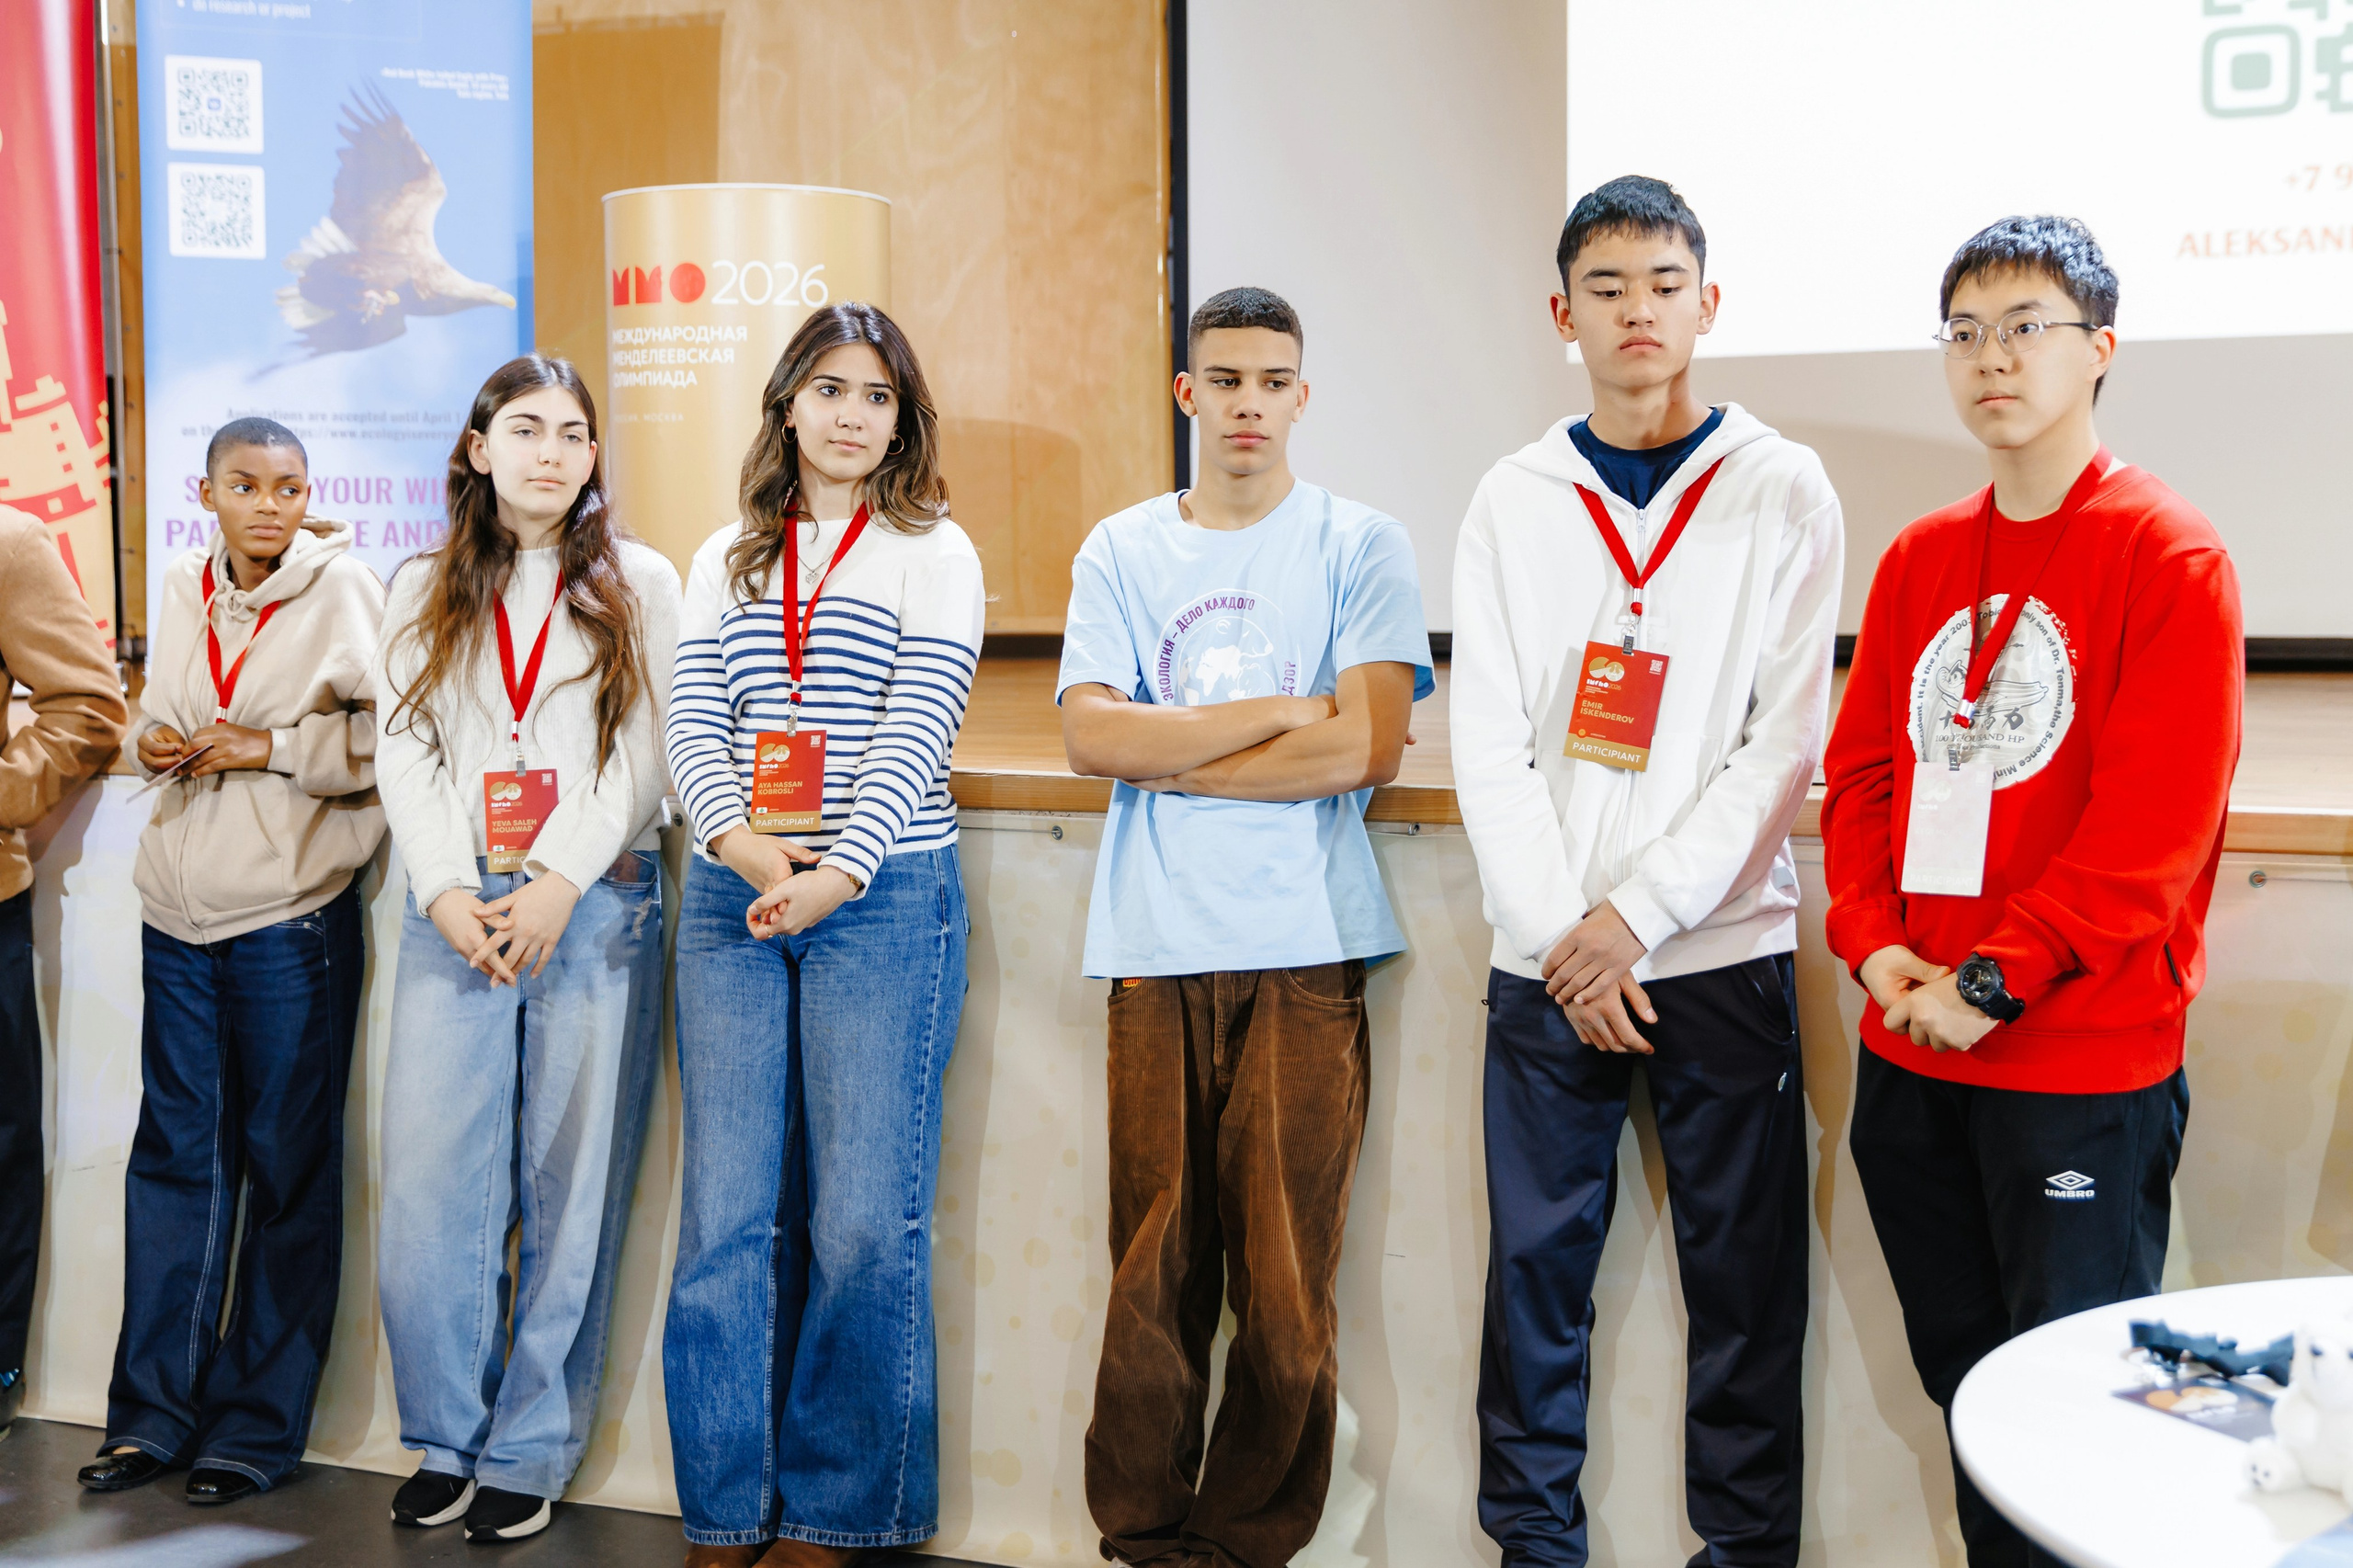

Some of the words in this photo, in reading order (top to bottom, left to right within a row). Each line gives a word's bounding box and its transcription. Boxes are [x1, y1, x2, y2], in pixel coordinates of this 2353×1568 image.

[2177, 225, 2353, 259] ALEKSAN
[710, 260, 828, 308] 2026
[612, 324, 748, 346] МЕЖДУНАРОДНАЯ
[612, 347, 735, 368] МЕНДЕЛЕЕВСКАЯ
[613, 369, 699, 389] ОЛИМПИАДА
[313, 476, 393, 505] YOUR
[1158, 639, 1176, 701] ЭКОЛОГИЯ
[1176, 606, 1203, 634] ДЕЛО
[1204, 596, 1256, 611] КАЖДОГО
[1924, 657, 1936, 676] the
[1934, 634, 1949, 658] year
[2020, 609, 2037, 624] only
[2034, 620, 2049, 636] son
[2046, 636, 2057, 647] of
[2052, 648, 2061, 665] Dr.
[1281, 660, 1296, 697] ДЗОР
[1581, 699, 1604, 710] EMIR
[1579, 707, 1635, 724] ISKENDEROV
[2007, 734, 2025, 744] HP
[1572, 742, 1642, 764] PARTICIPIANT
[492, 825, 533, 834] MOUAWAD
[513, 818, 538, 826] SALEH
[756, 817, 815, 827] PARTICIPIANT
[2044, 1188, 2095, 1198] UMBRO
